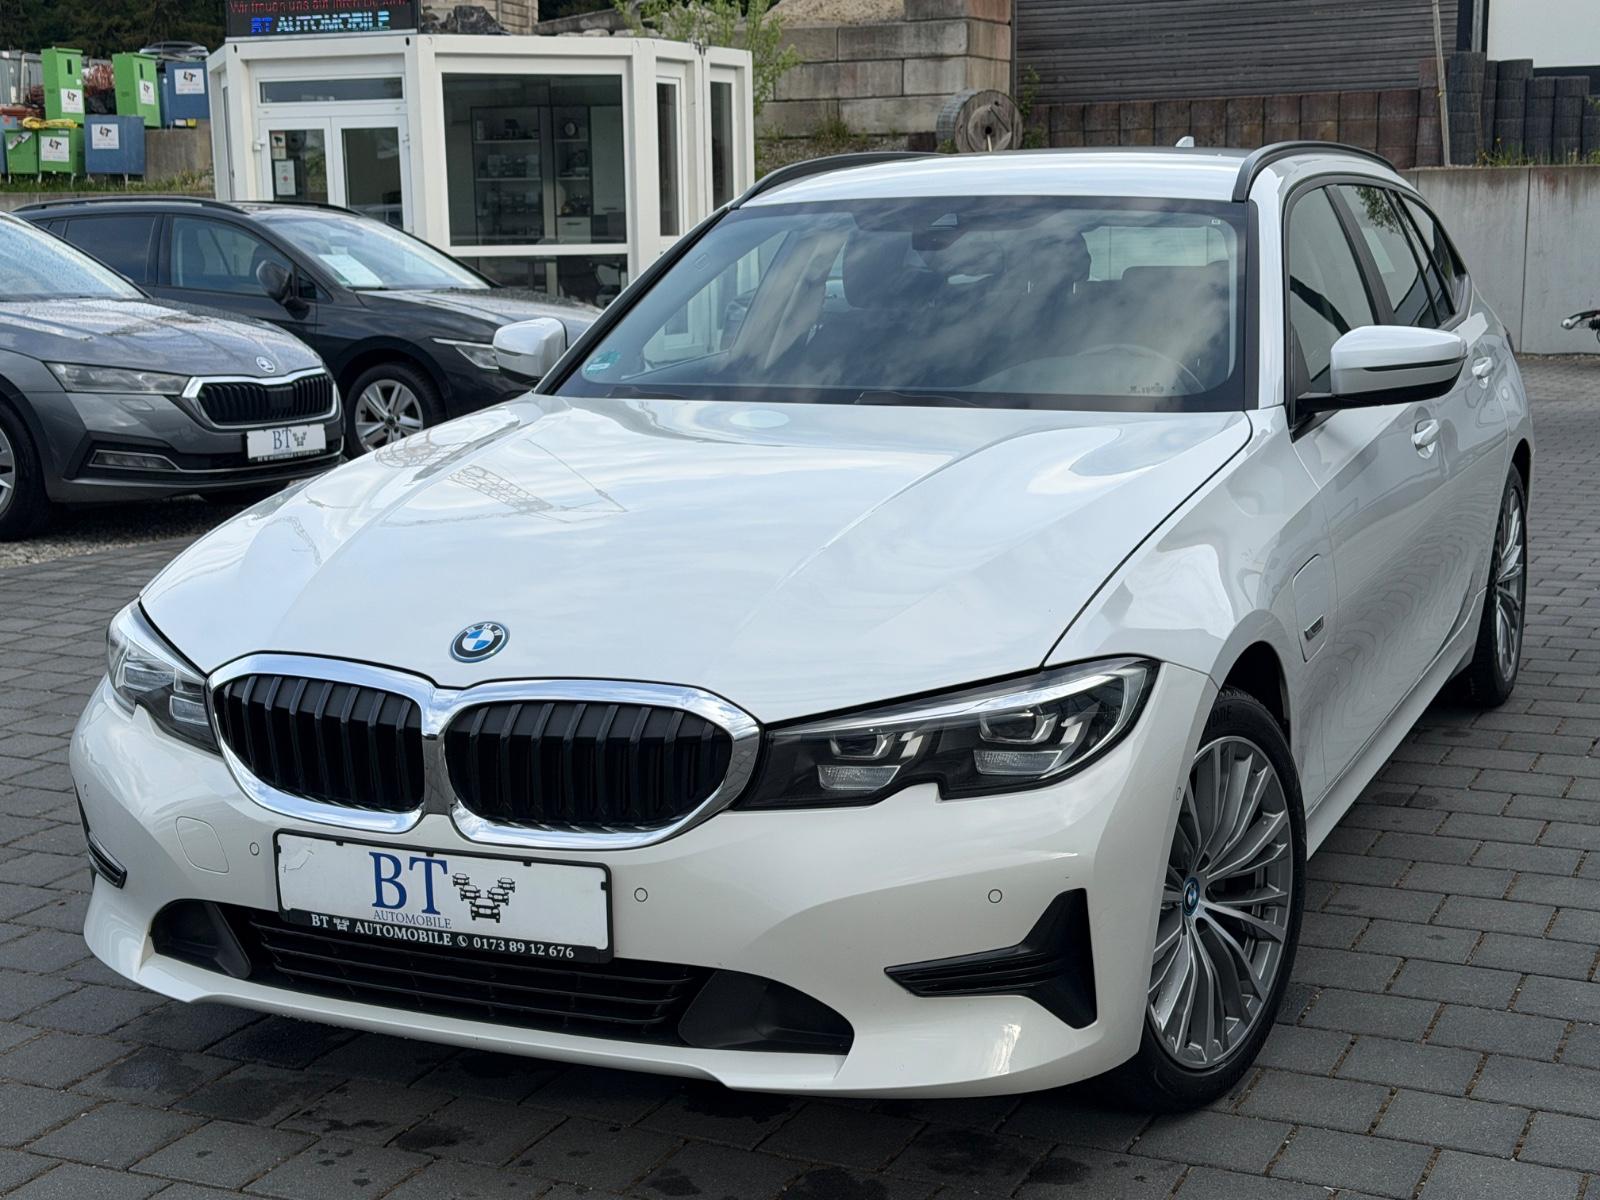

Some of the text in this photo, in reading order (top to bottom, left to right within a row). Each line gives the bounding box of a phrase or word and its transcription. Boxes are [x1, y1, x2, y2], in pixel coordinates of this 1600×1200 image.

[276, 11, 390, 32] AUTOMOBILE
[272, 428, 292, 450] BT
[368, 851, 448, 916] BT
[373, 909, 452, 929] AUTOMOBILE
[310, 913, 575, 959] BT AUTOMOBILE 0173 89 12 676
